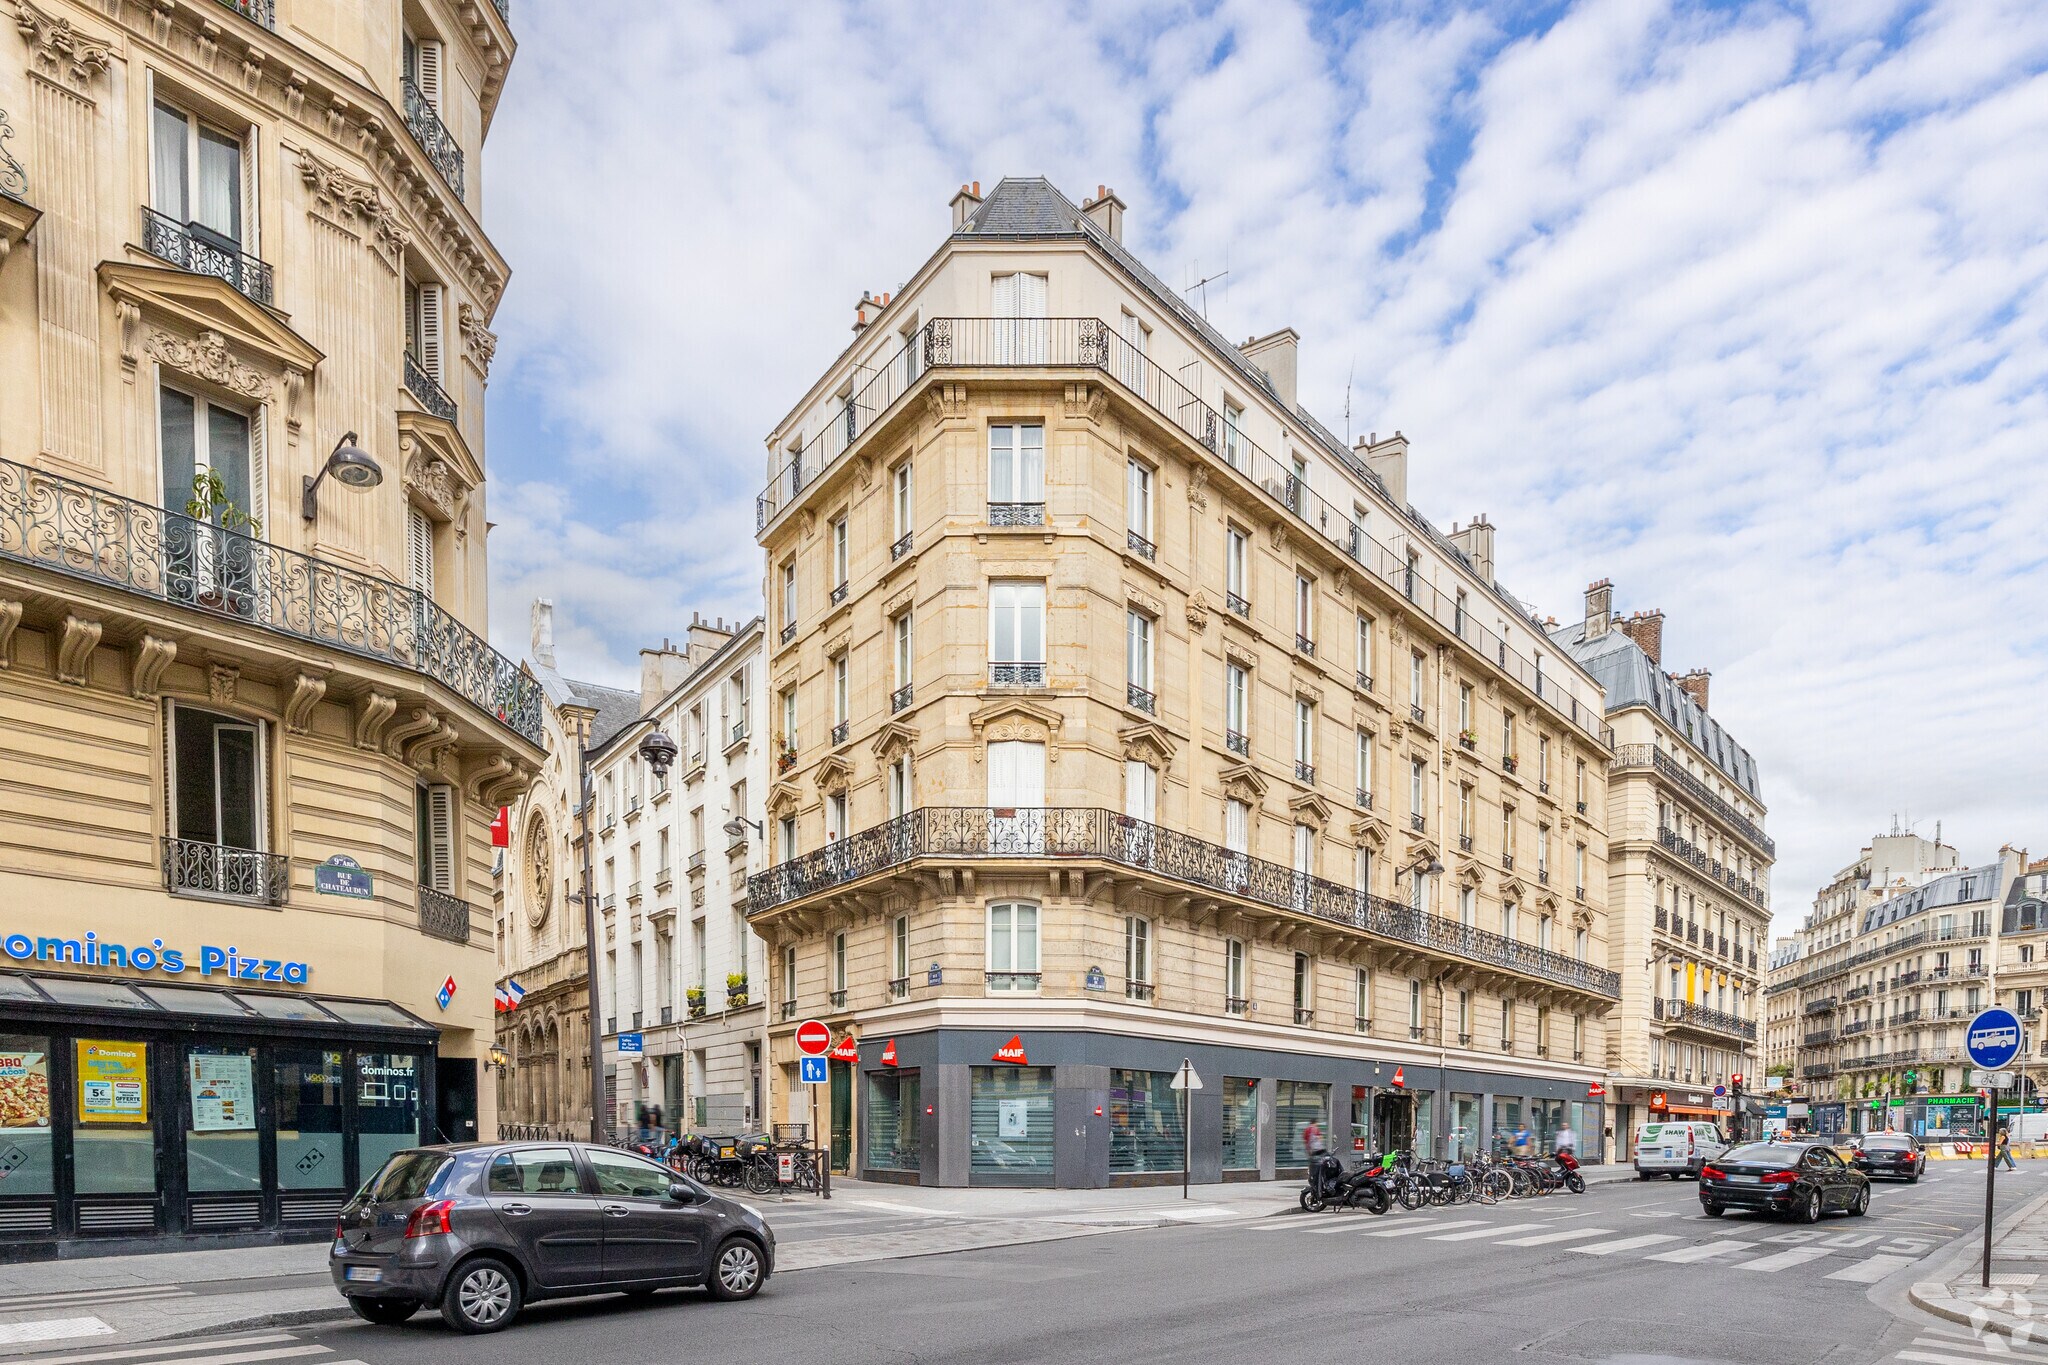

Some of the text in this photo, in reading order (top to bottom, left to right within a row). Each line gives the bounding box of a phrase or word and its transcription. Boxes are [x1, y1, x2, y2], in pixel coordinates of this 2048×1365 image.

[337, 871, 352, 880] RUE
[320, 882, 369, 895] CHATEAUDUN
[0, 930, 309, 985] omino's Pizza
[99, 1049, 137, 1058] Domino's
[834, 1048, 857, 1057] MAIF
[998, 1048, 1025, 1058] MAIF
[0, 1068, 27, 1076] ACON
[361, 1065, 415, 1077] dominos.fr
[92, 1088, 105, 1098] 5€
[1927, 1097, 1975, 1105] PHARMACIE
[1759, 1230, 1937, 1254] BUS
